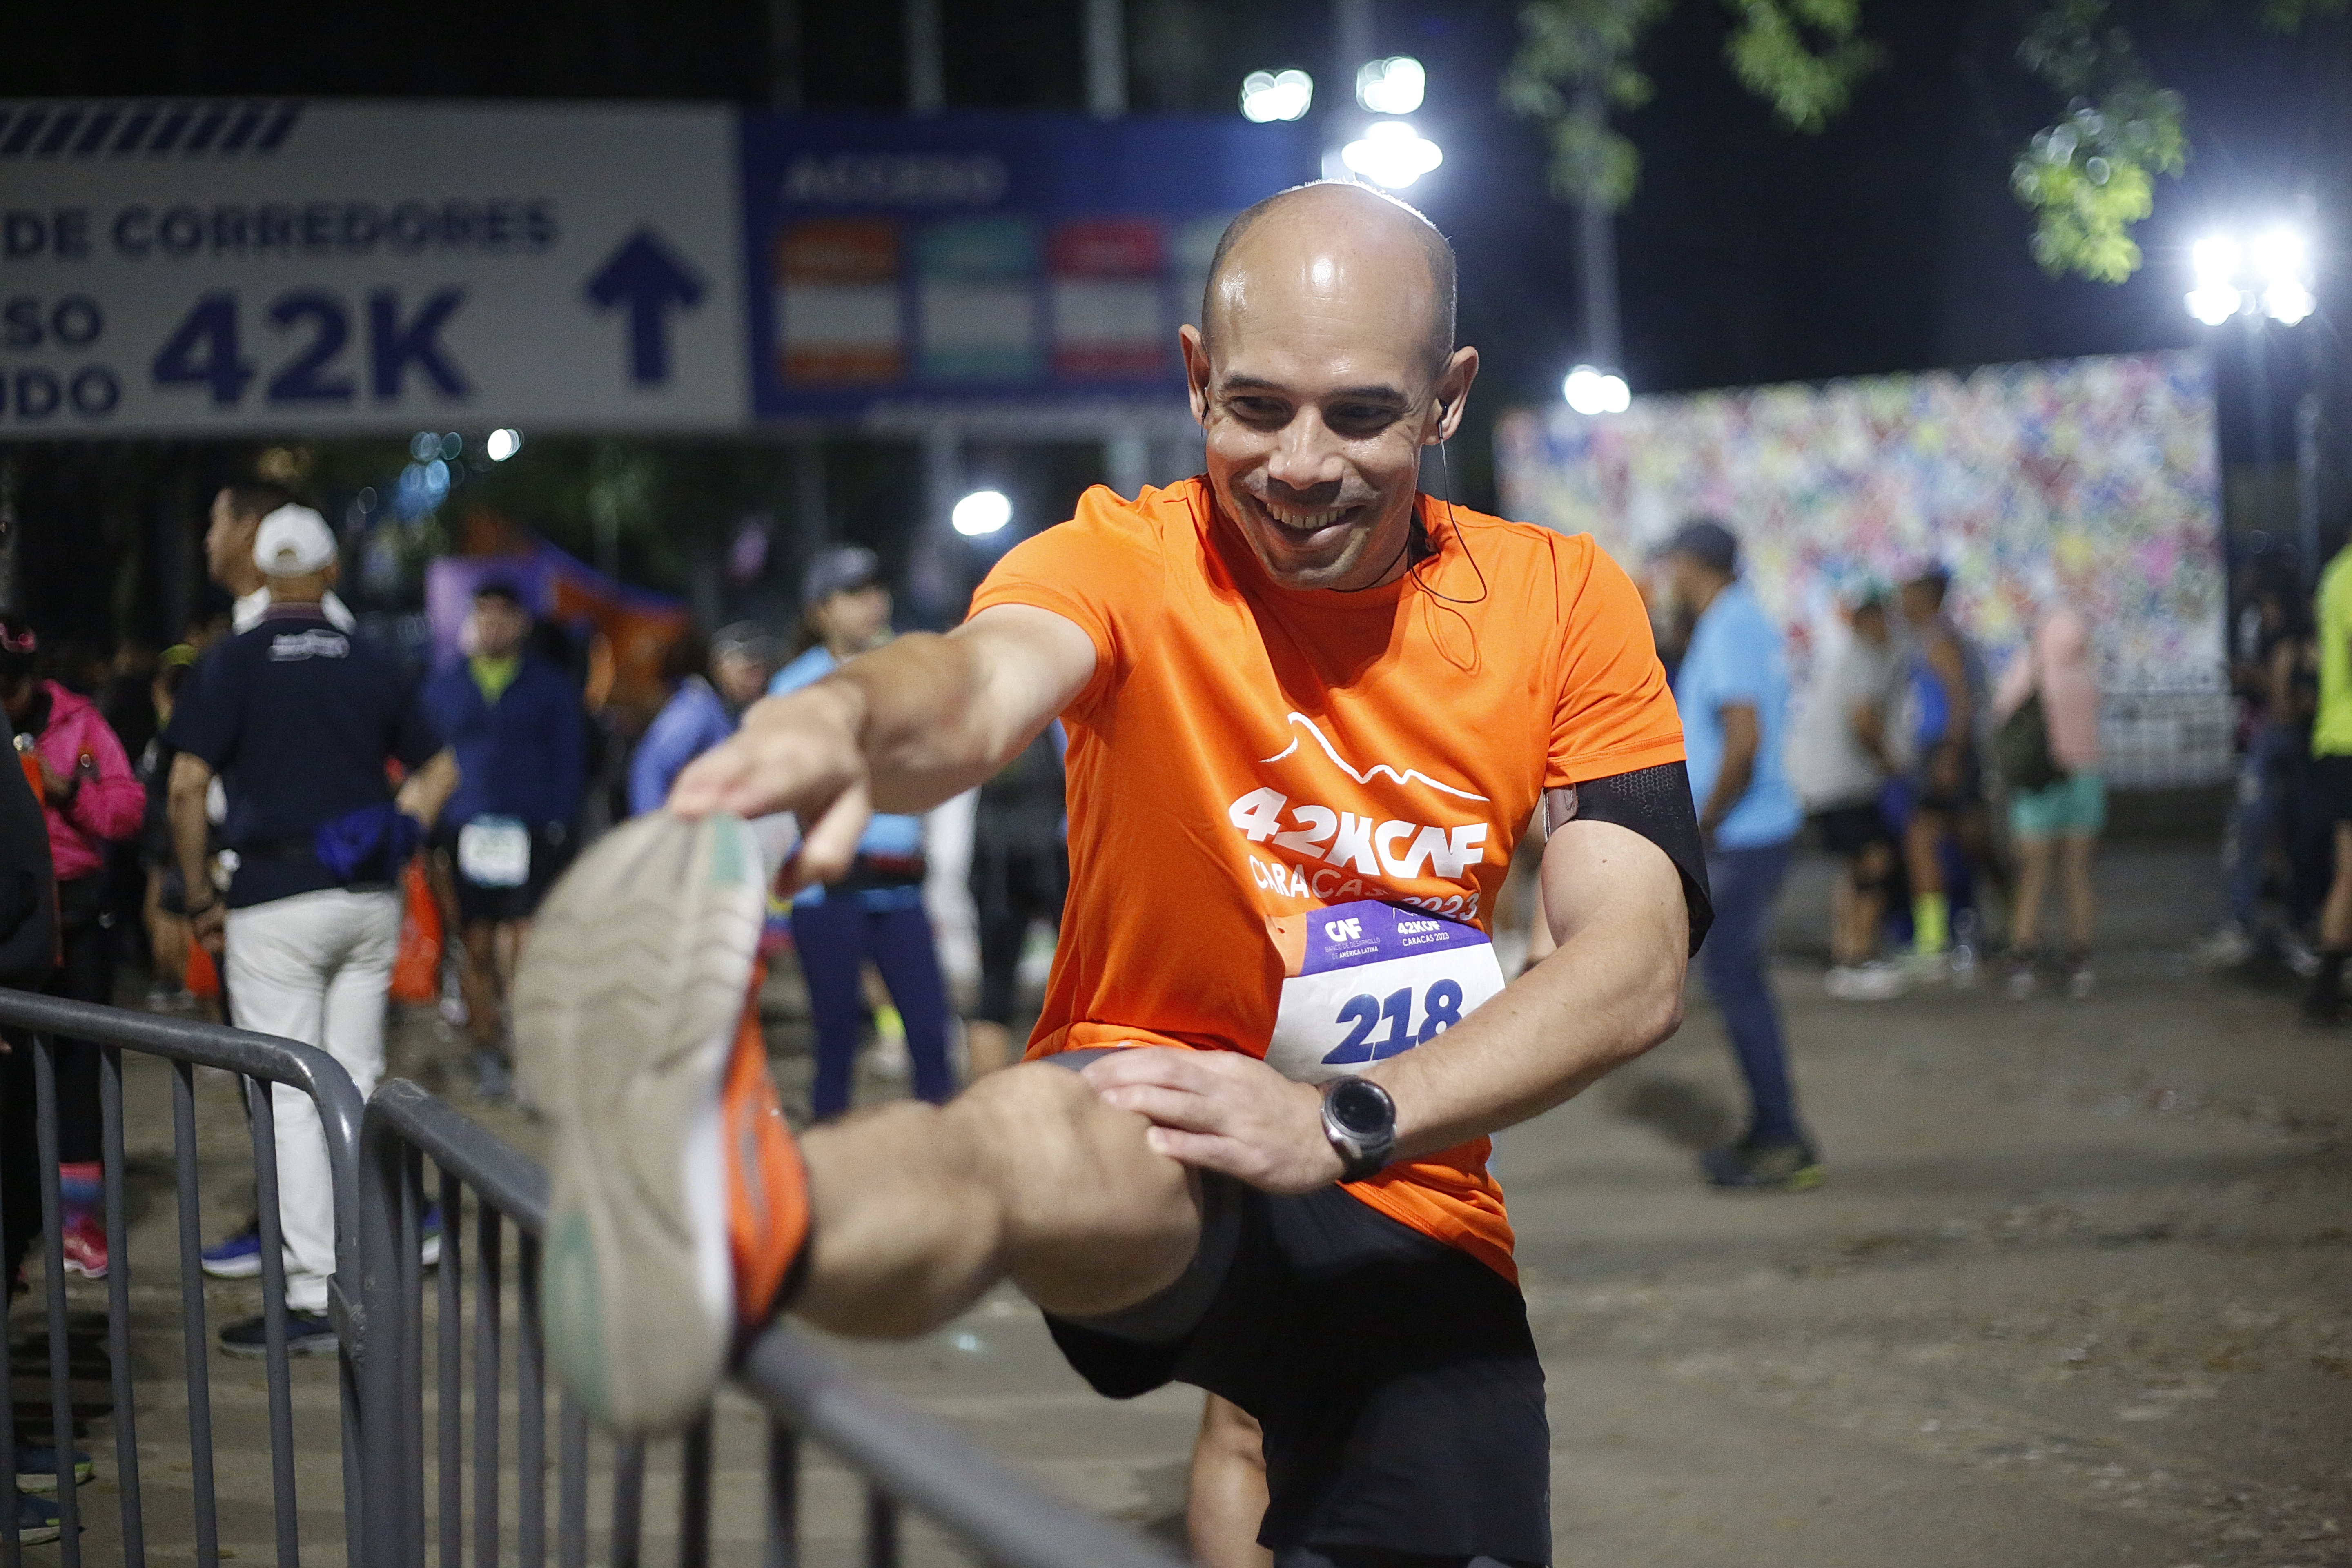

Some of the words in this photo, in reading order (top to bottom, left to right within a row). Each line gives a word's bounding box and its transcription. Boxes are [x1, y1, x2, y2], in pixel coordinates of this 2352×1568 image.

[3, 209, 88, 259] DE
[110, 201, 556, 258] CORREDORES
[150, 287, 468, 406] 42K
[0, 368, 121, 419] DO
[1325, 917, 1363, 942] CAF
[1325, 944, 1343, 952] BANCO
[1350, 937, 1381, 948] DESARROLLO
[1402, 934, 1435, 947] CARACAS
[1434, 932, 1450, 942] 2023
[1339, 949, 1361, 959] AMÉRICA
[1361, 946, 1379, 955] LATINA
[1321, 978, 1463, 1064] 218
